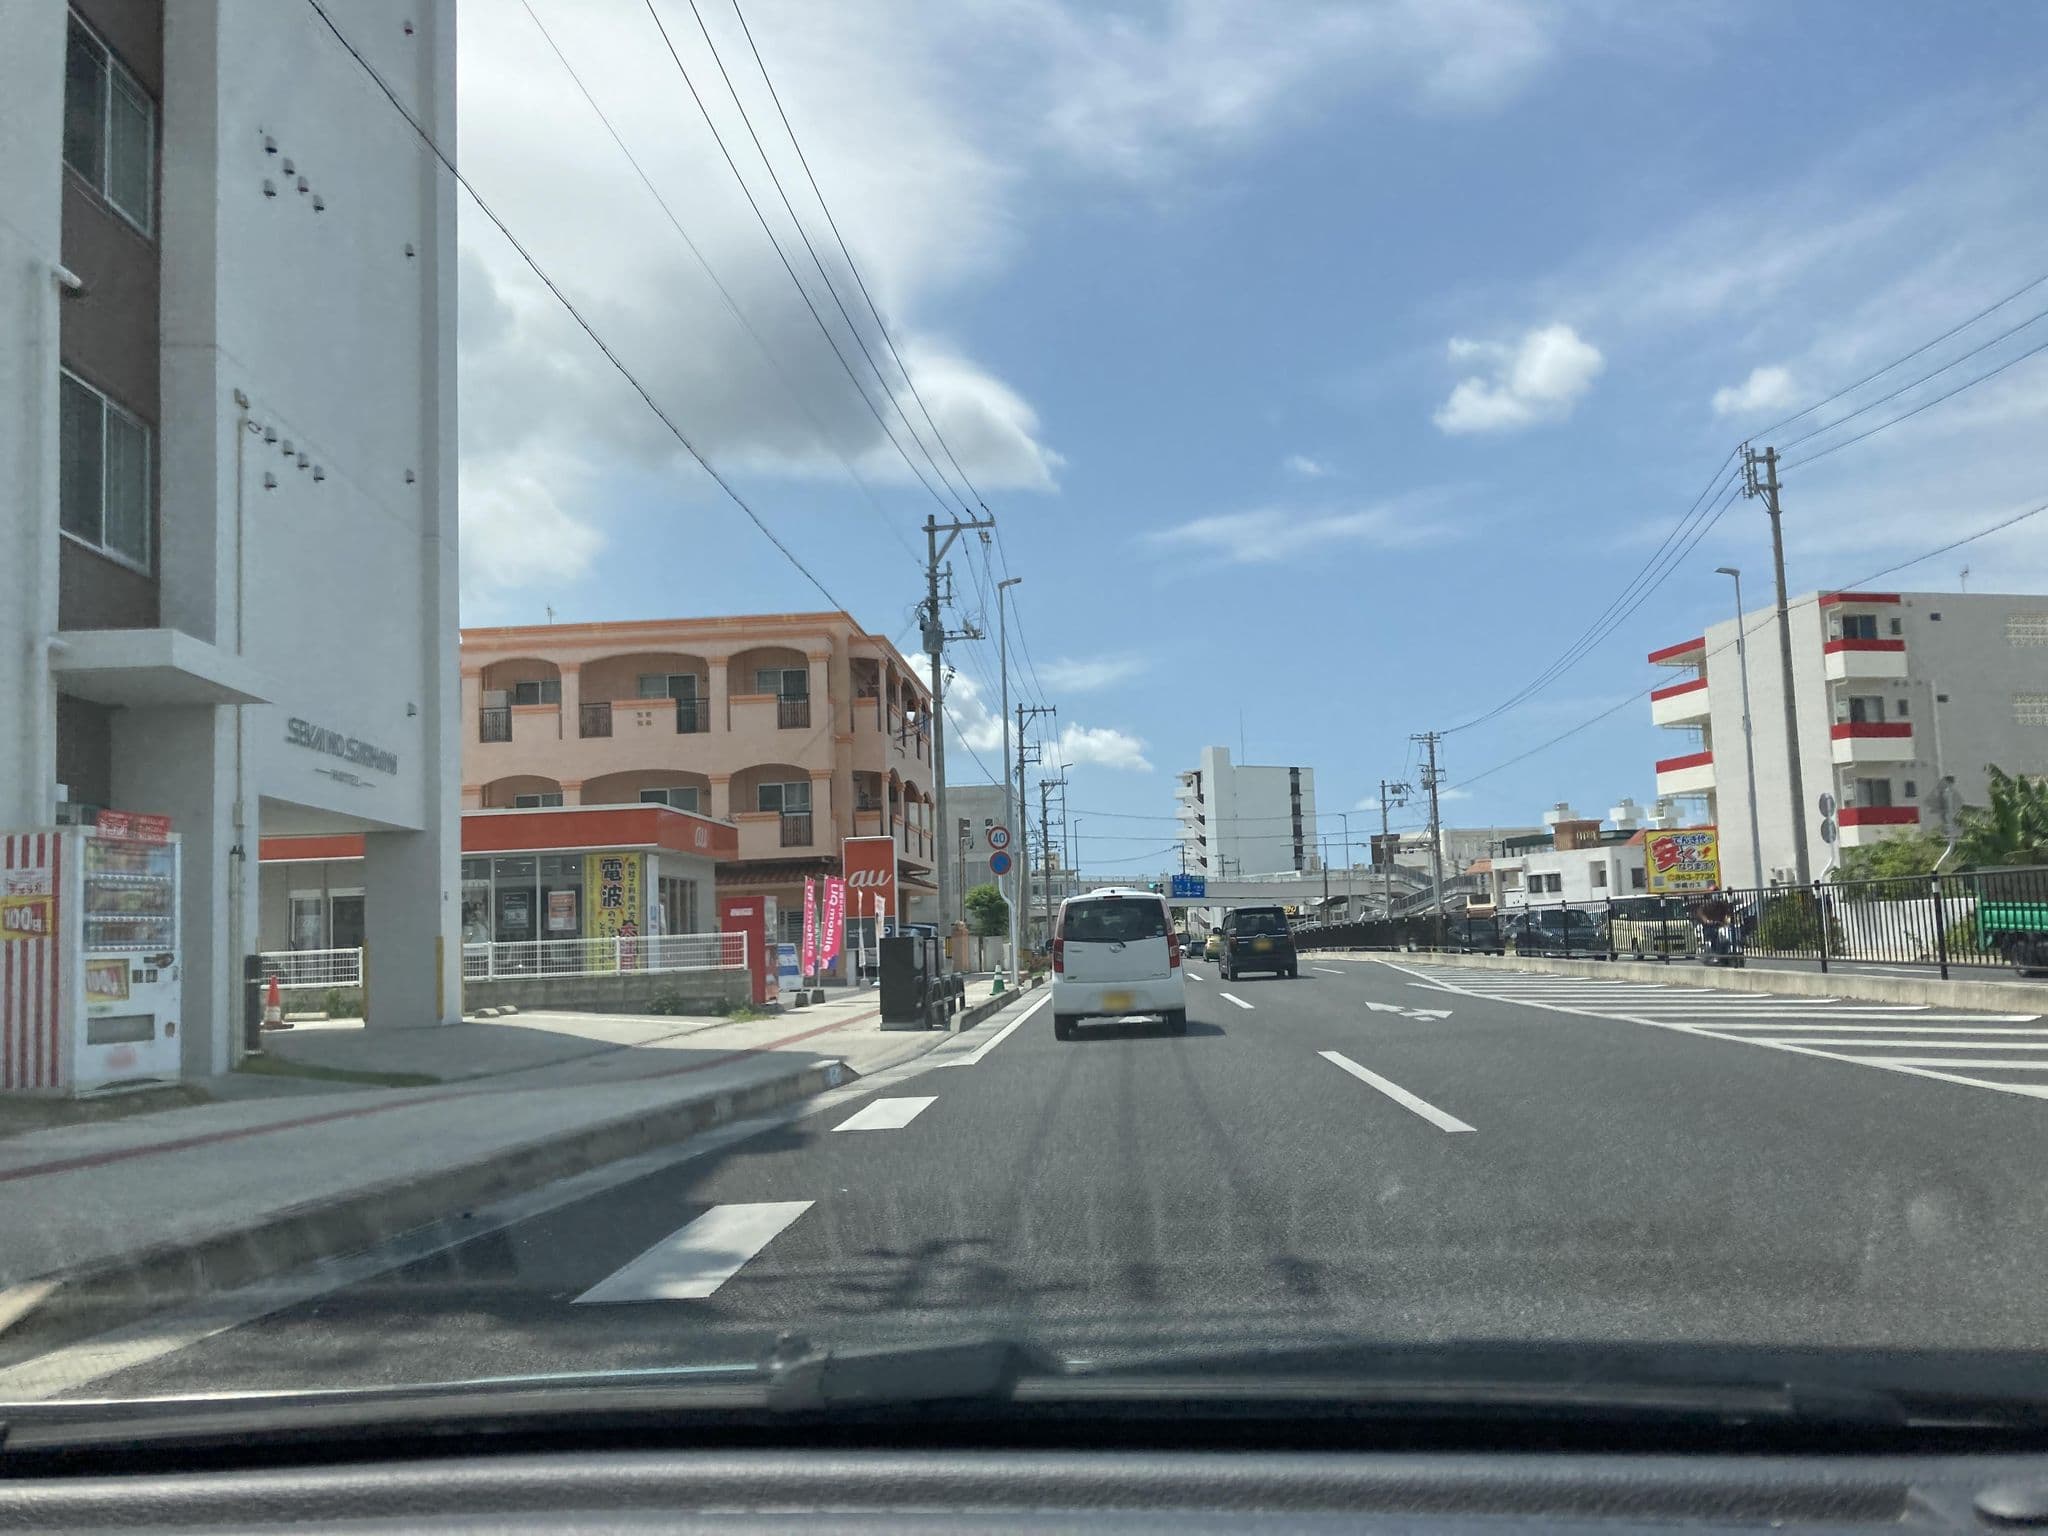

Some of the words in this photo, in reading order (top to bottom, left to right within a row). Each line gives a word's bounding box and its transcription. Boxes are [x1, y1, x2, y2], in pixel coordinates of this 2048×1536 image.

[695, 826, 708, 848] au
[992, 832, 1006, 843] 40
[602, 858, 623, 908] 電波
[848, 869, 892, 888] au
[828, 883, 839, 906] UQ
[823, 908, 835, 952] mobile
